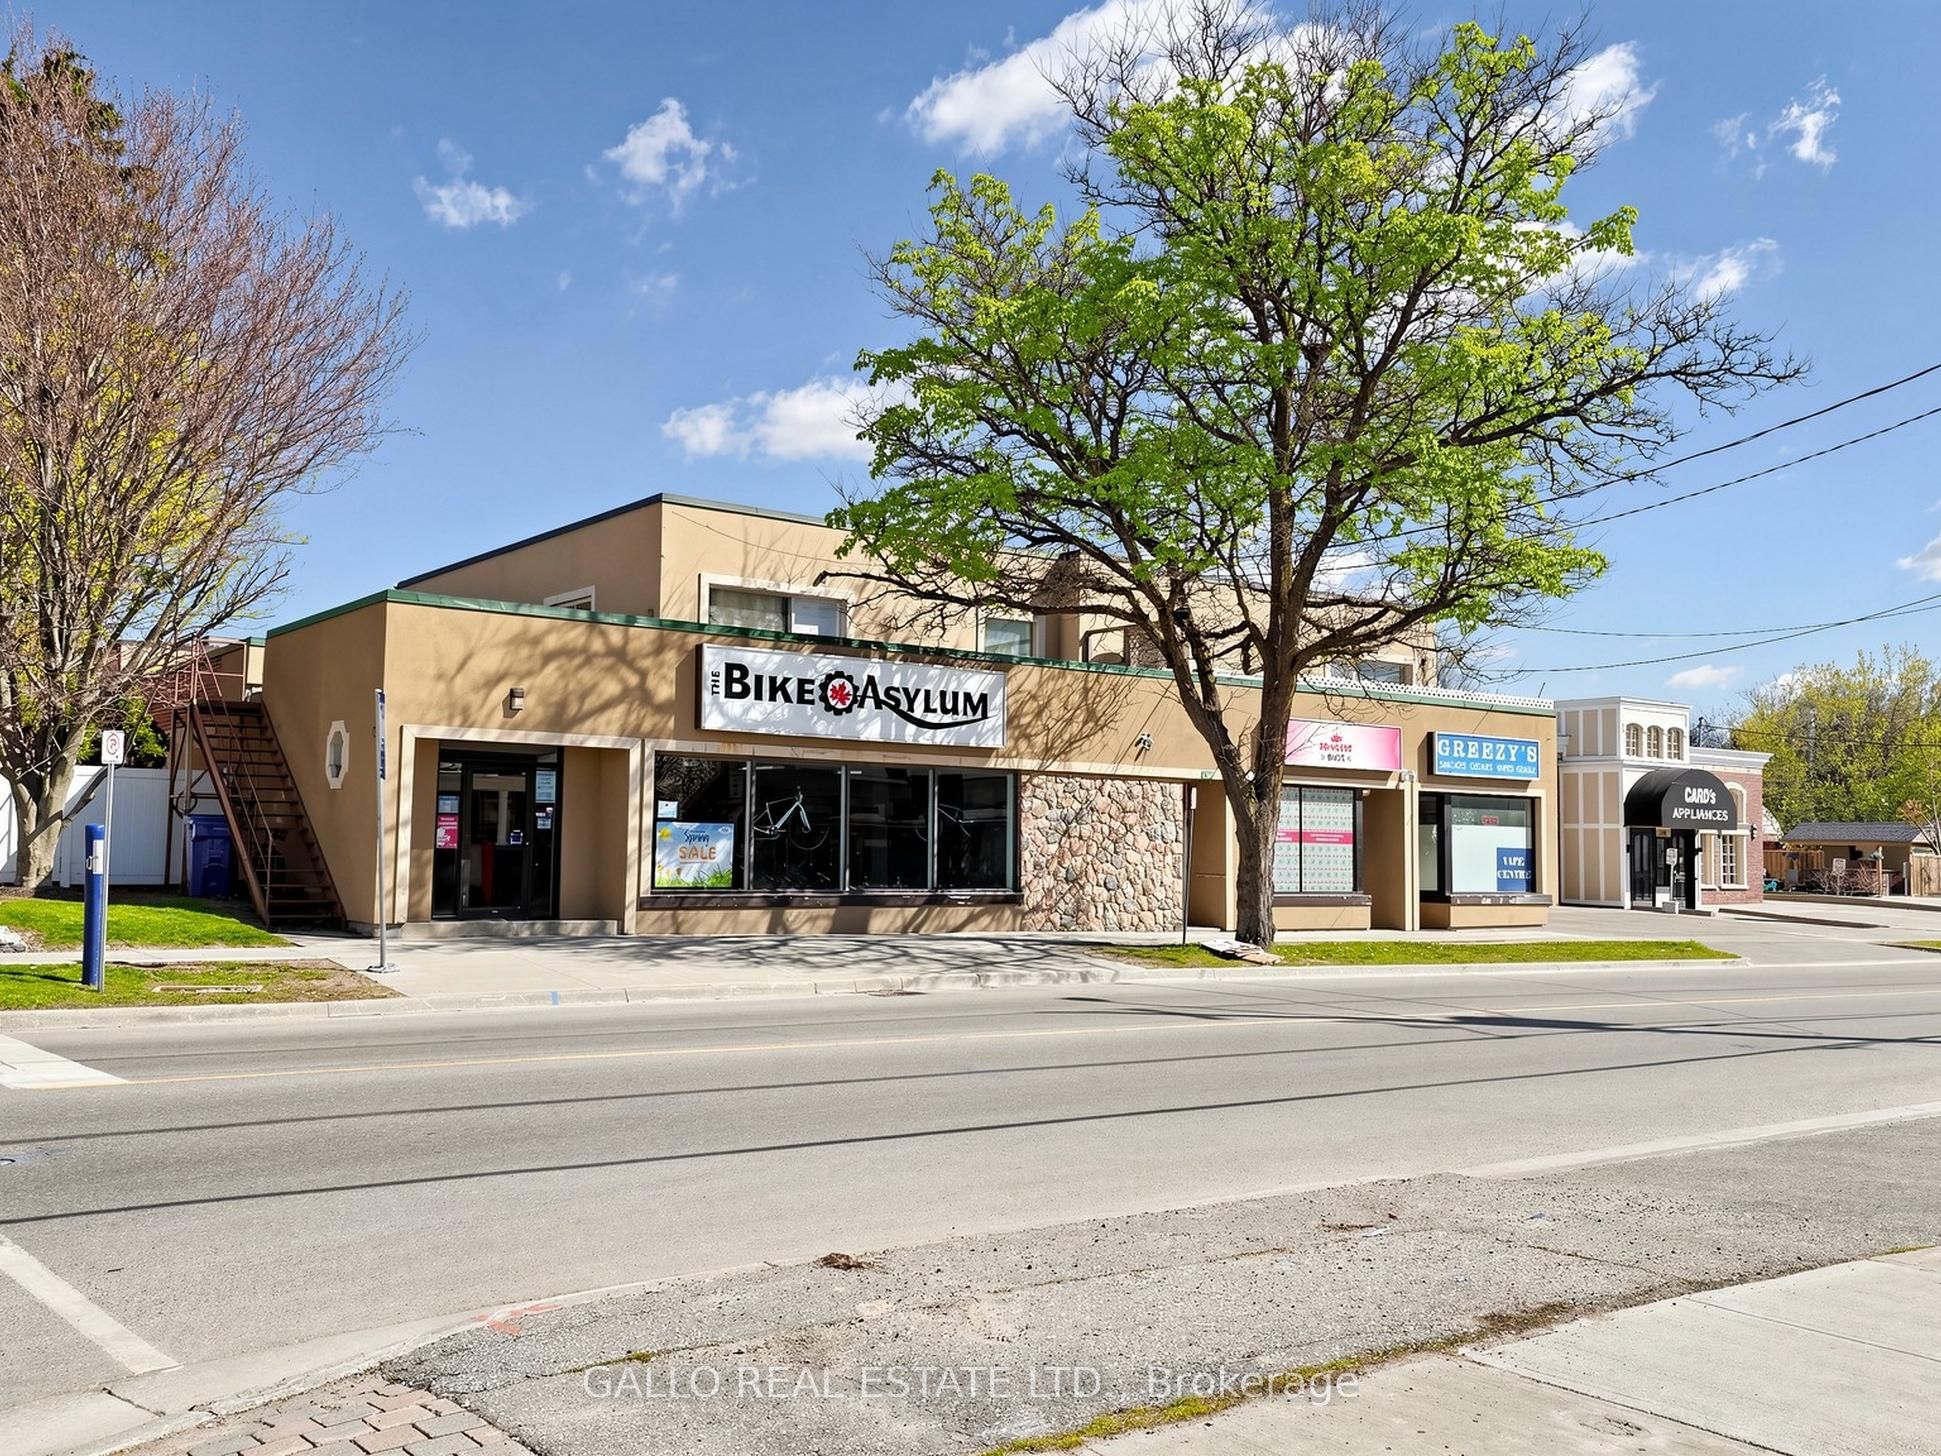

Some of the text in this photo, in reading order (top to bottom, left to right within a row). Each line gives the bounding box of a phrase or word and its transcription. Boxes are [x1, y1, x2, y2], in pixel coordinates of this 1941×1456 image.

[711, 670, 721, 696] THE
[1438, 739, 1538, 763] GREEZY'S
[678, 845, 717, 860] SALE
